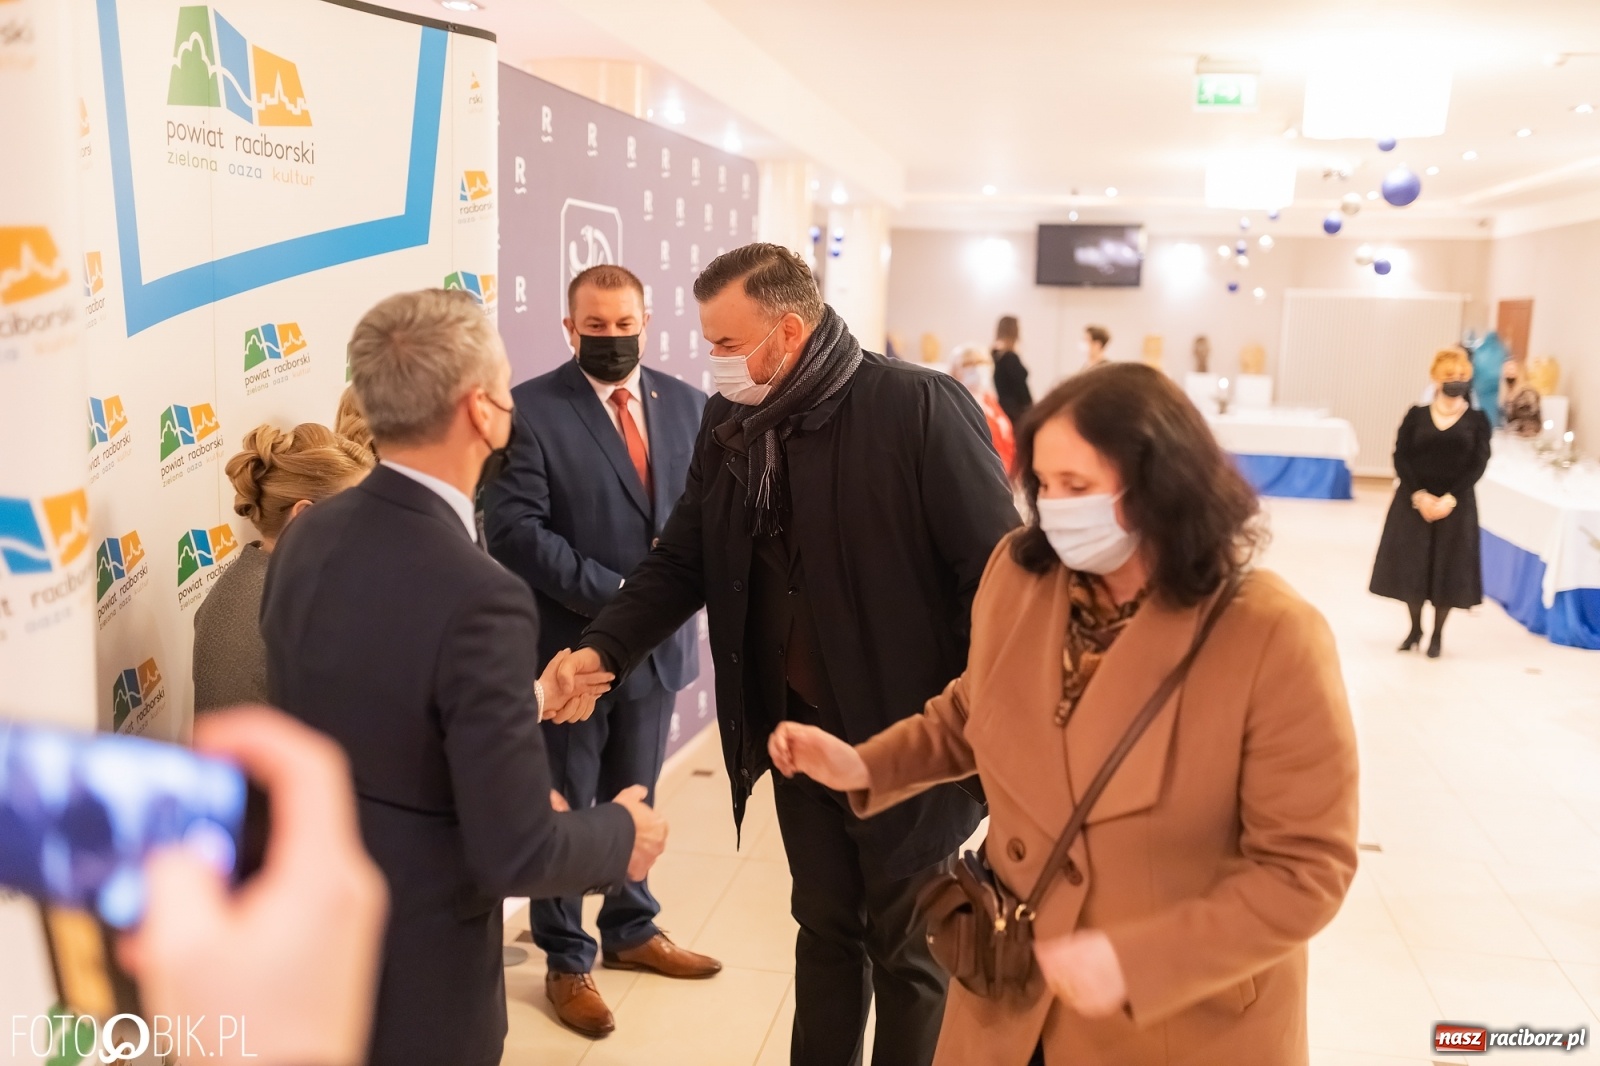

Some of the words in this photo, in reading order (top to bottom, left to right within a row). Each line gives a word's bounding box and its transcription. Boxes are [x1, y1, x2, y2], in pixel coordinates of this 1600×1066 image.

[542, 105, 553, 133] R
[166, 120, 224, 149] powiat
[235, 132, 315, 165] raciborski
[588, 122, 598, 148] R
[627, 135, 637, 162] R
[167, 149, 218, 172] zielona
[228, 163, 262, 179] oaza
[272, 166, 315, 187] kultur
[515, 156, 527, 185] R
[515, 275, 527, 303] R
[244, 368, 270, 389] powiat
[274, 352, 311, 375] raciborski
[246, 382, 269, 396] zielona
[272, 375, 289, 386] oaza
[102, 430, 131, 460] raciborski
[160, 455, 185, 480] powiat
[187, 434, 224, 461] raciborski
[162, 471, 184, 488] zielona
[186, 461, 203, 474] oaza
[97, 591, 118, 623] powiat
[119, 561, 149, 596] raciborski
[118, 594, 132, 610] oaza
[178, 577, 203, 604] powiat
[180, 592, 202, 611] zielona
[136, 685, 165, 724] raciborski
